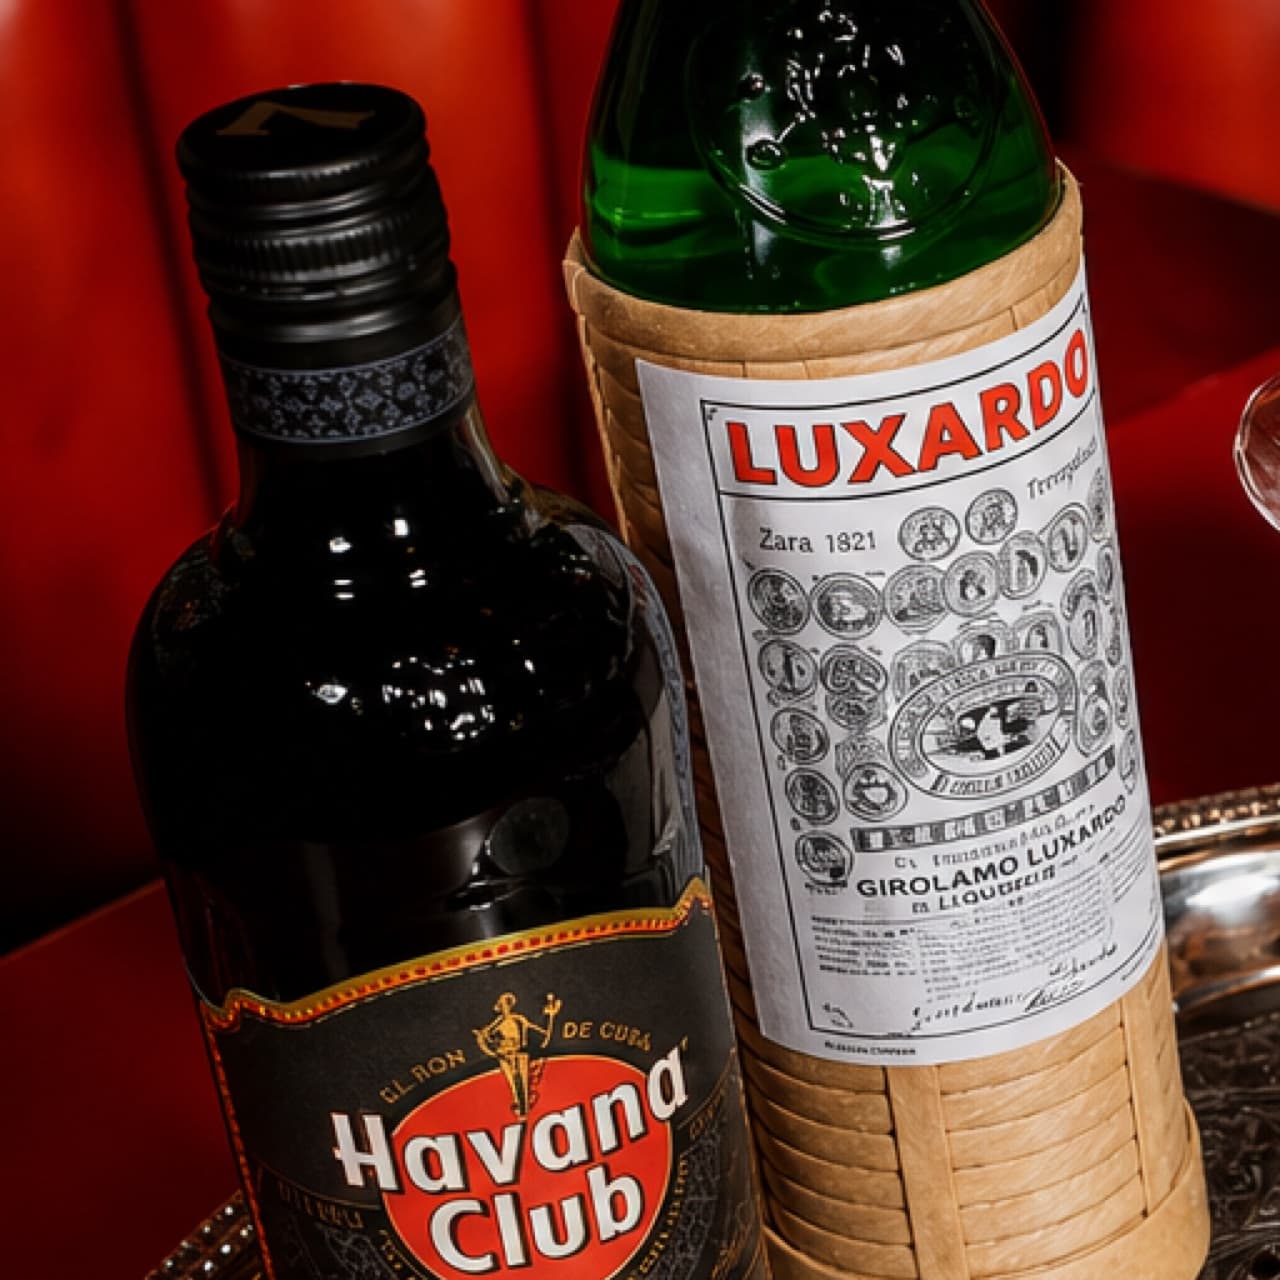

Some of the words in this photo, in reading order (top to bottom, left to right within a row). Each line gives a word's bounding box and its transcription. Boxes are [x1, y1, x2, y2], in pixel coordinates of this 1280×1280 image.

[726, 329, 1090, 488] LUXARDO
[759, 526, 814, 554] Zara
[826, 530, 877, 554] 1821
[856, 856, 1020, 898] GIROLAMO
[562, 1021, 593, 1040] DE
[331, 1049, 689, 1194] Havana
[429, 1165, 643, 1275] Club
